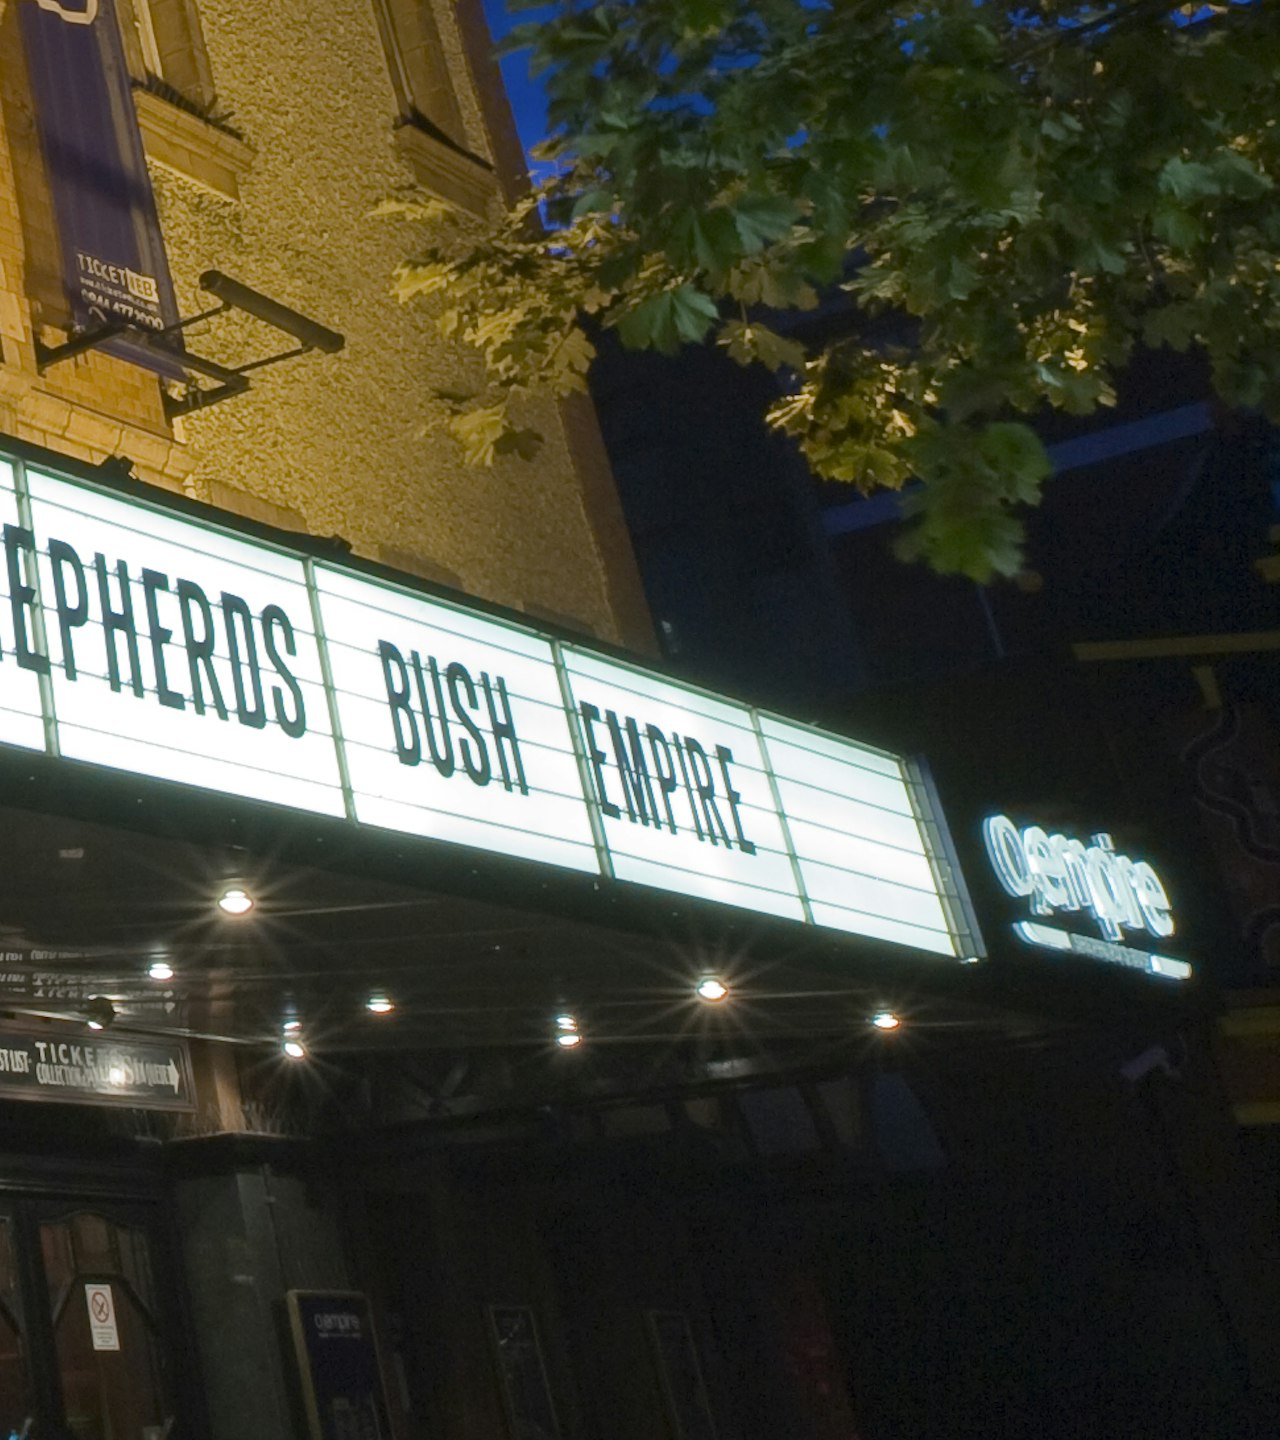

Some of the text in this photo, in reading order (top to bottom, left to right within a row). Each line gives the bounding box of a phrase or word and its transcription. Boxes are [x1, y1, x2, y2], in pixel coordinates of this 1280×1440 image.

[378, 639, 529, 796] BUSH
[581, 700, 757, 856] EMPIRE
[10, 1049, 29, 1073] LIST
